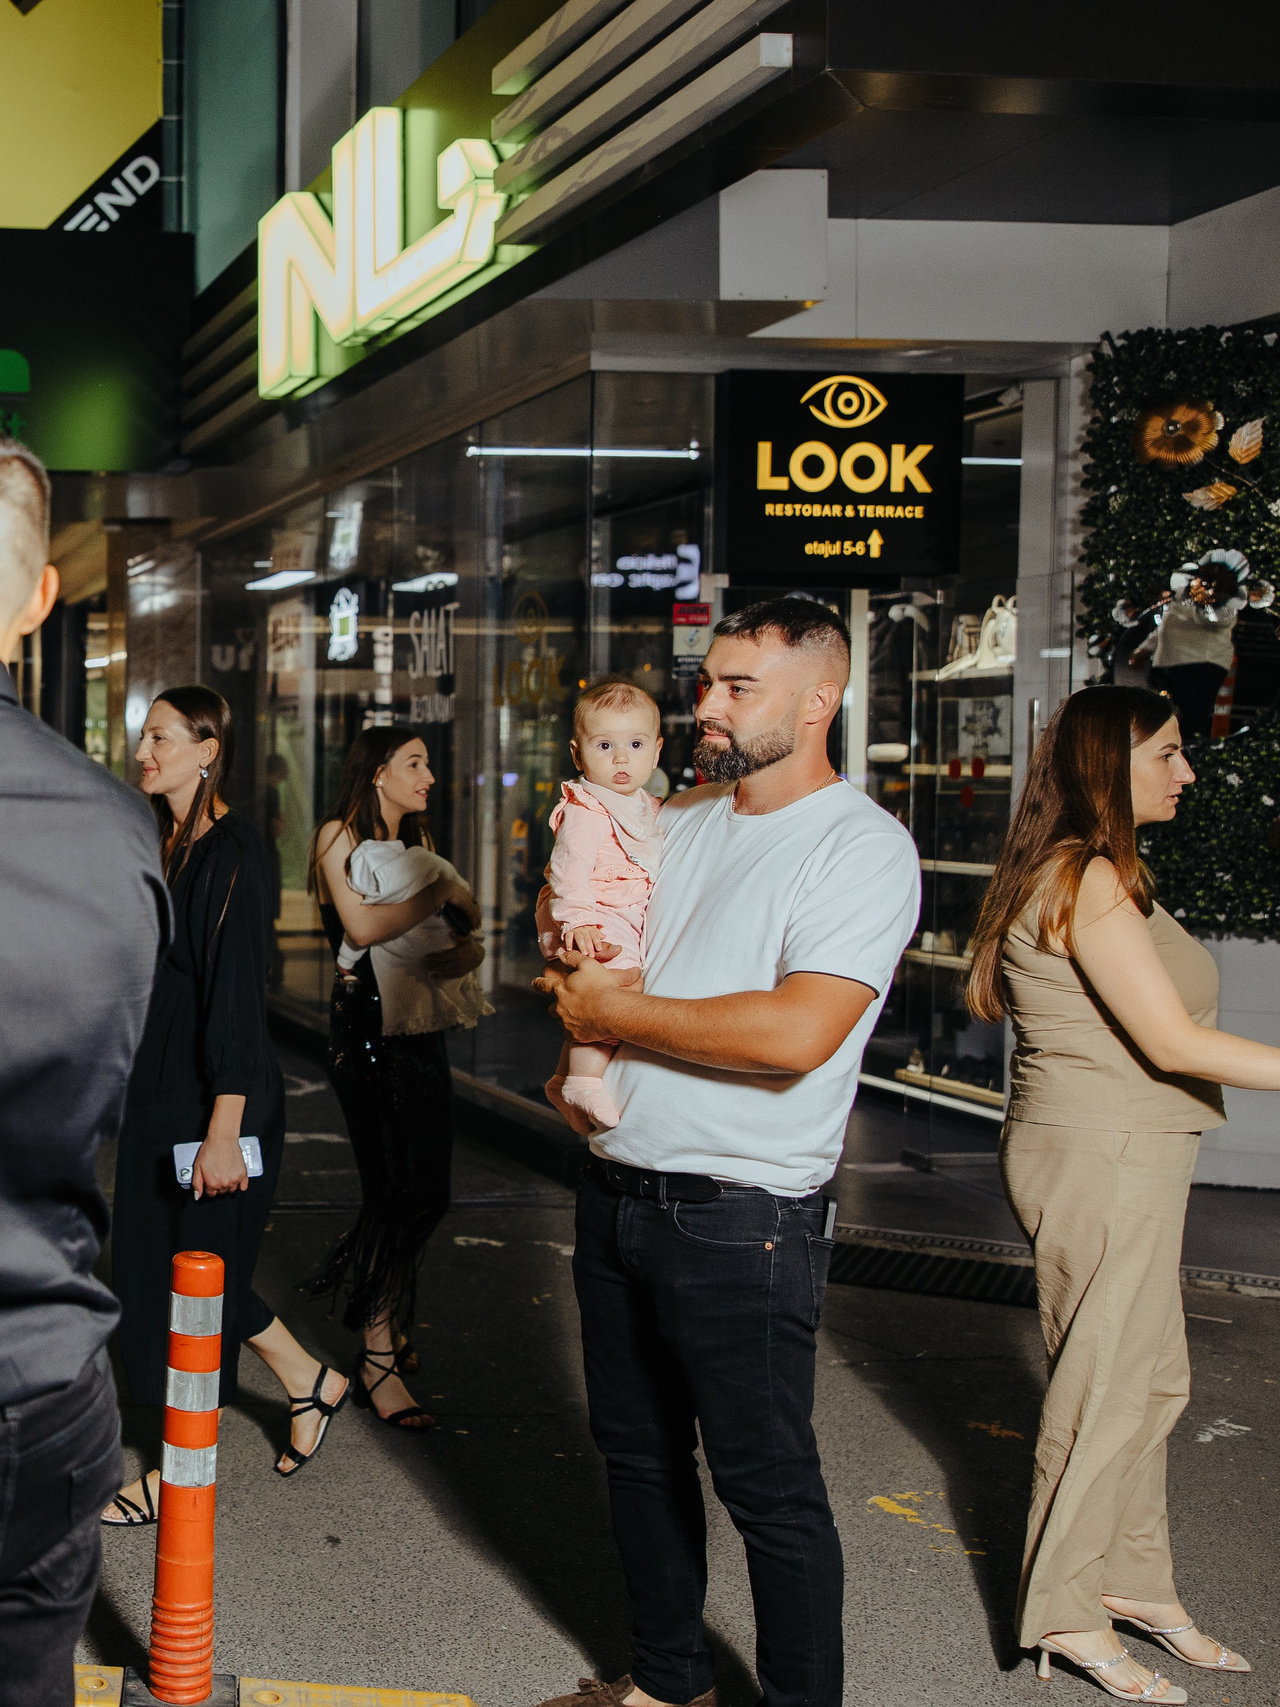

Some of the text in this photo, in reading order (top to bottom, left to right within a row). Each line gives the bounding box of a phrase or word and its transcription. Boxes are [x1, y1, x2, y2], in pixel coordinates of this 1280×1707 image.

[756, 440, 934, 494] LOOK
[765, 503, 925, 519] RESTOBAR & TERRACE
[804, 540, 866, 558] etajul 5-6
